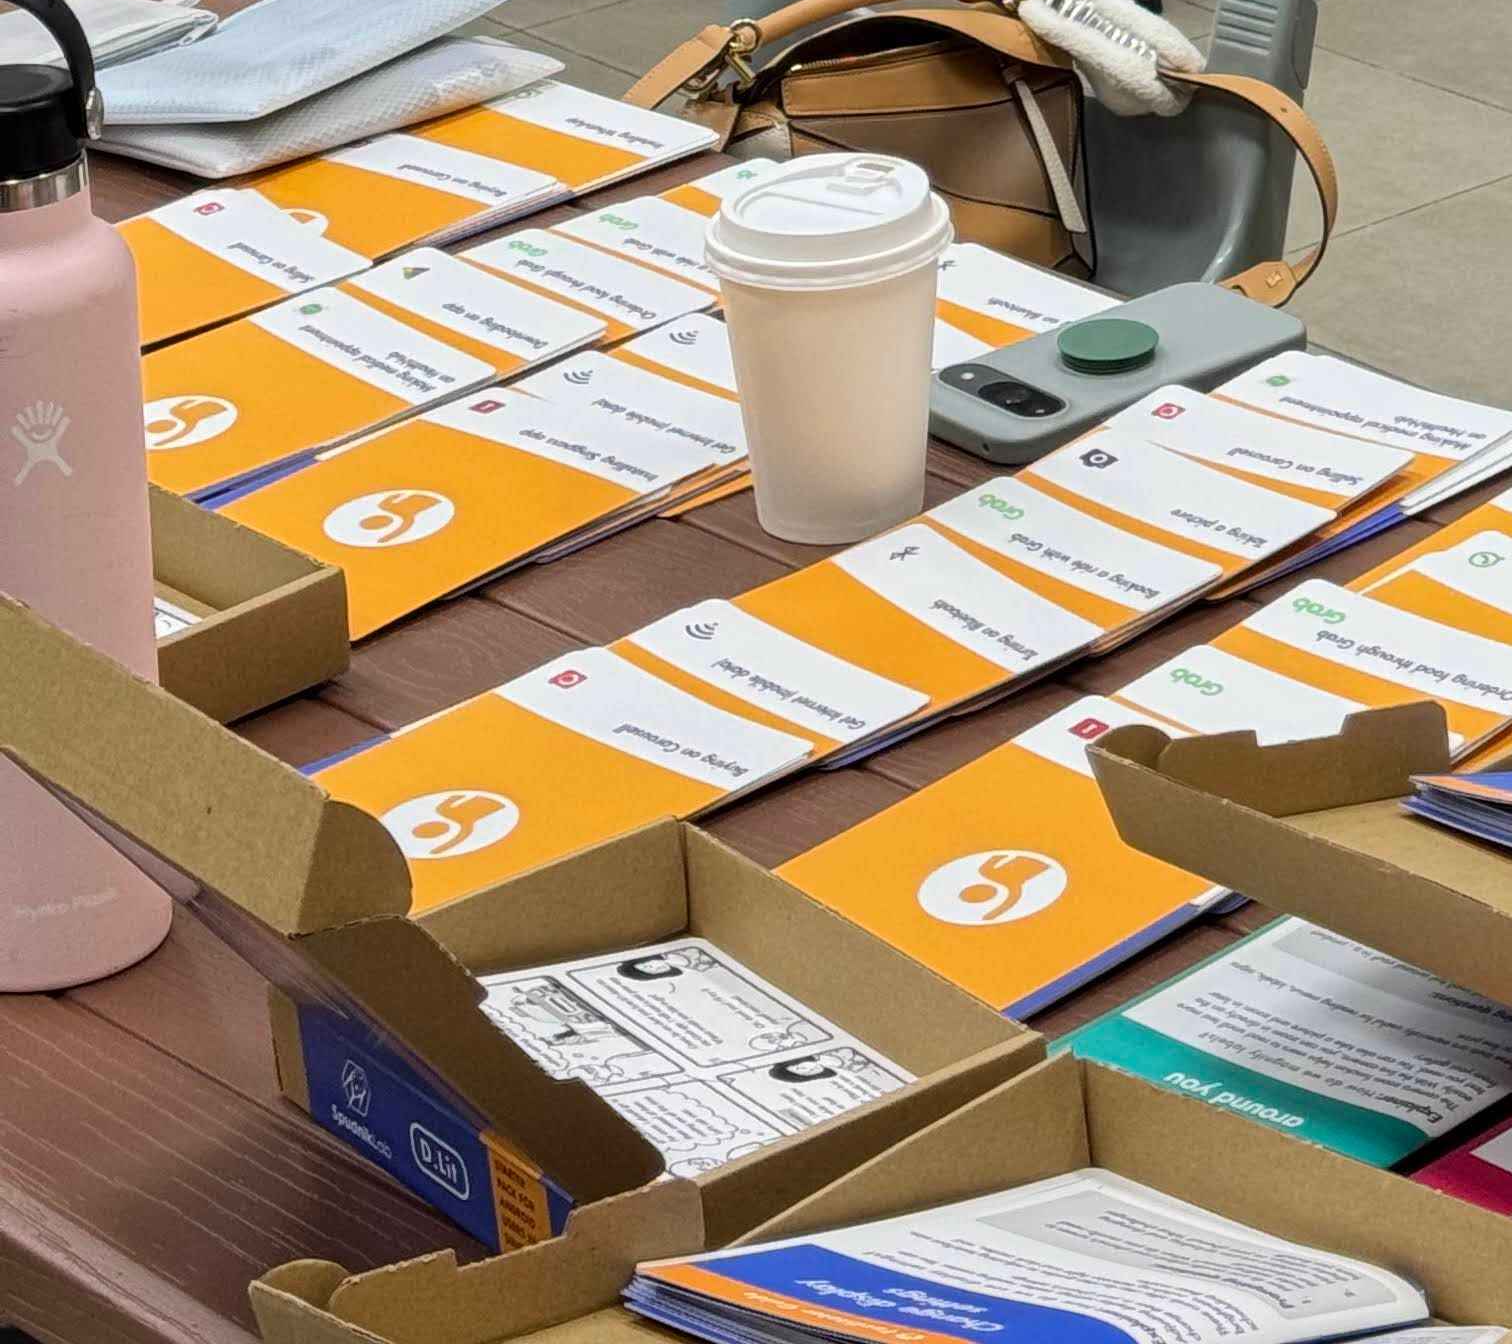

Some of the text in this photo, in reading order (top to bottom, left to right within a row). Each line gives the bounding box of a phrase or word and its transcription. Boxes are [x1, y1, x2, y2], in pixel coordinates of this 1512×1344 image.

[599, 214, 639, 231] Grab
[509, 241, 548, 257] Grab
[609, 295, 657, 320] Ordering
[442, 304, 549, 350] Downloading an app
[1279, 396, 1472, 451] Making medical appointment
[1468, 432, 1487, 440] on
[519, 430, 659, 482] Installing Singpass app
[1226, 448, 1364, 486] Selling on Carousell
[978, 494, 1025, 521] Grab
[1171, 509, 1220, 528] picture
[1226, 528, 1268, 549] Taking
[1008, 534, 1161, 600] Booking a ride with Grab
[1293, 598, 1346, 625] Grab
[982, 628, 1001, 638] on
[1316, 630, 1356, 650] Grab
[997, 634, 1039, 661] Turning
[1356, 645, 1414, 670] through
[1170, 668, 1225, 697] Grab
[1408, 664, 1451, 683] food
[711, 658, 867, 730] Get Internet (mobile data)
[612, 724, 749, 778] Buying on Carousell
[1163, 1072, 1305, 1127] around you
[1346, 1085, 1376, 1098] How
[1376, 1094, 1444, 1124] Explainer:
[331, 1104, 392, 1160] SpudnikLab
[420, 1137, 458, 1184] D.Lit
[898, 1304, 1005, 1332] Change
